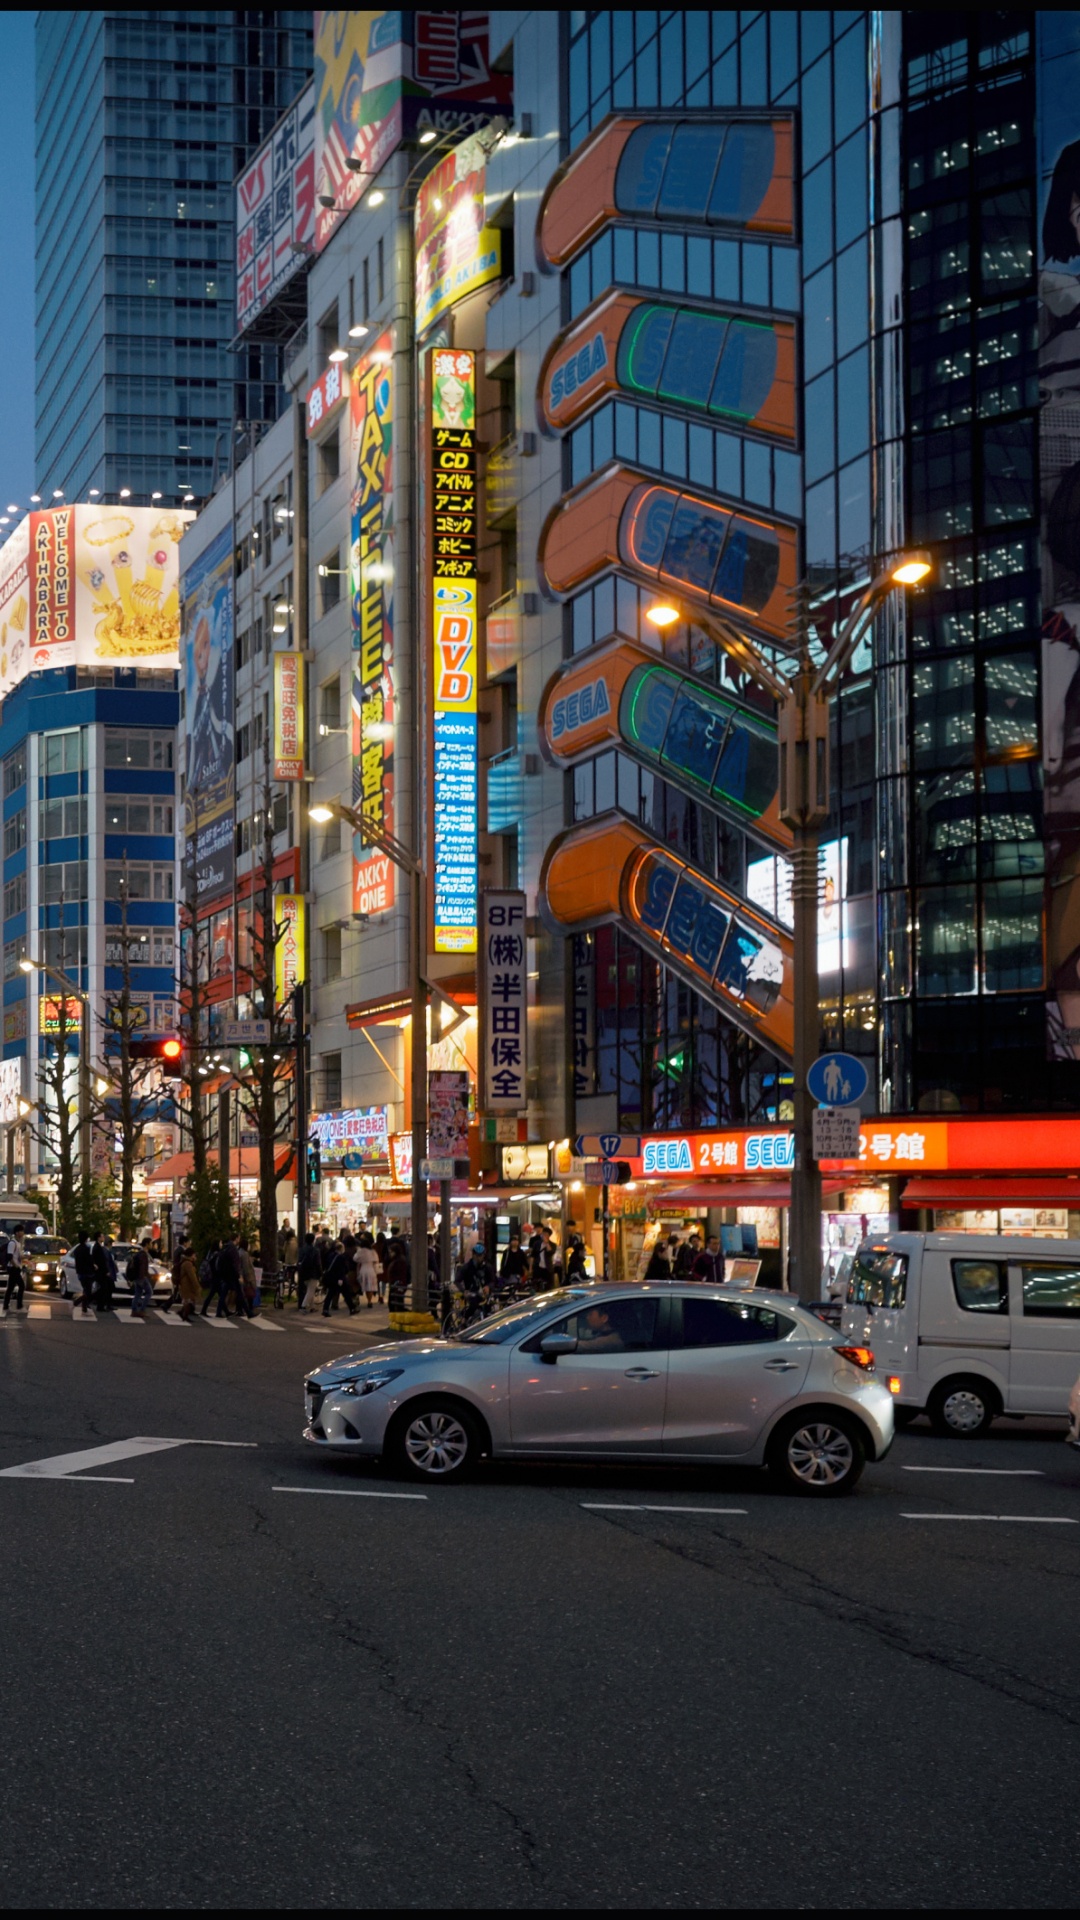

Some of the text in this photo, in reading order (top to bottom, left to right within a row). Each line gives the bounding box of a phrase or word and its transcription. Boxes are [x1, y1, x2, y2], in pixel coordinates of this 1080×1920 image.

[434, 352, 473, 377] 激安
[549, 331, 608, 412] SEGA
[308, 361, 341, 428] 免税
[436, 431, 473, 448] ゲーム
[440, 451, 469, 470] CD
[435, 473, 474, 491] アイドル
[435, 495, 474, 512] アニメ
[359, 361, 384, 687] TAX FREE
[435, 516, 473, 534] コミック
[54, 513, 69, 605] WELCOME
[438, 538, 471, 555] ホビー
[436, 559, 473, 577] フィギュア
[38, 523, 49, 641] AKIHABARA
[56, 612, 68, 637] TO
[438, 614, 473, 701] DVD
[281, 656, 297, 757] 愛客旺免税店
[551, 675, 611, 741] SEGA
[277, 760, 301, 769] AKKY
[279, 769, 299, 777] ONE
[356, 858, 390, 892] AKKY
[360, 885, 386, 914] ONE
[488, 906, 523, 927] 8F
[284, 926, 297, 957] TAX
[228, 1023, 266, 1034] 万世橋
[488, 933, 524, 1099] (株)半田保全
[329, 1120, 344, 1138] ONE
[603, 1137, 618, 1151] 17
[643, 1139, 695, 1173] SEGA
[699, 1141, 738, 1166] 2号館
[858, 1132, 926, 1161] 2号館
[603, 1164, 612, 1179] 17
